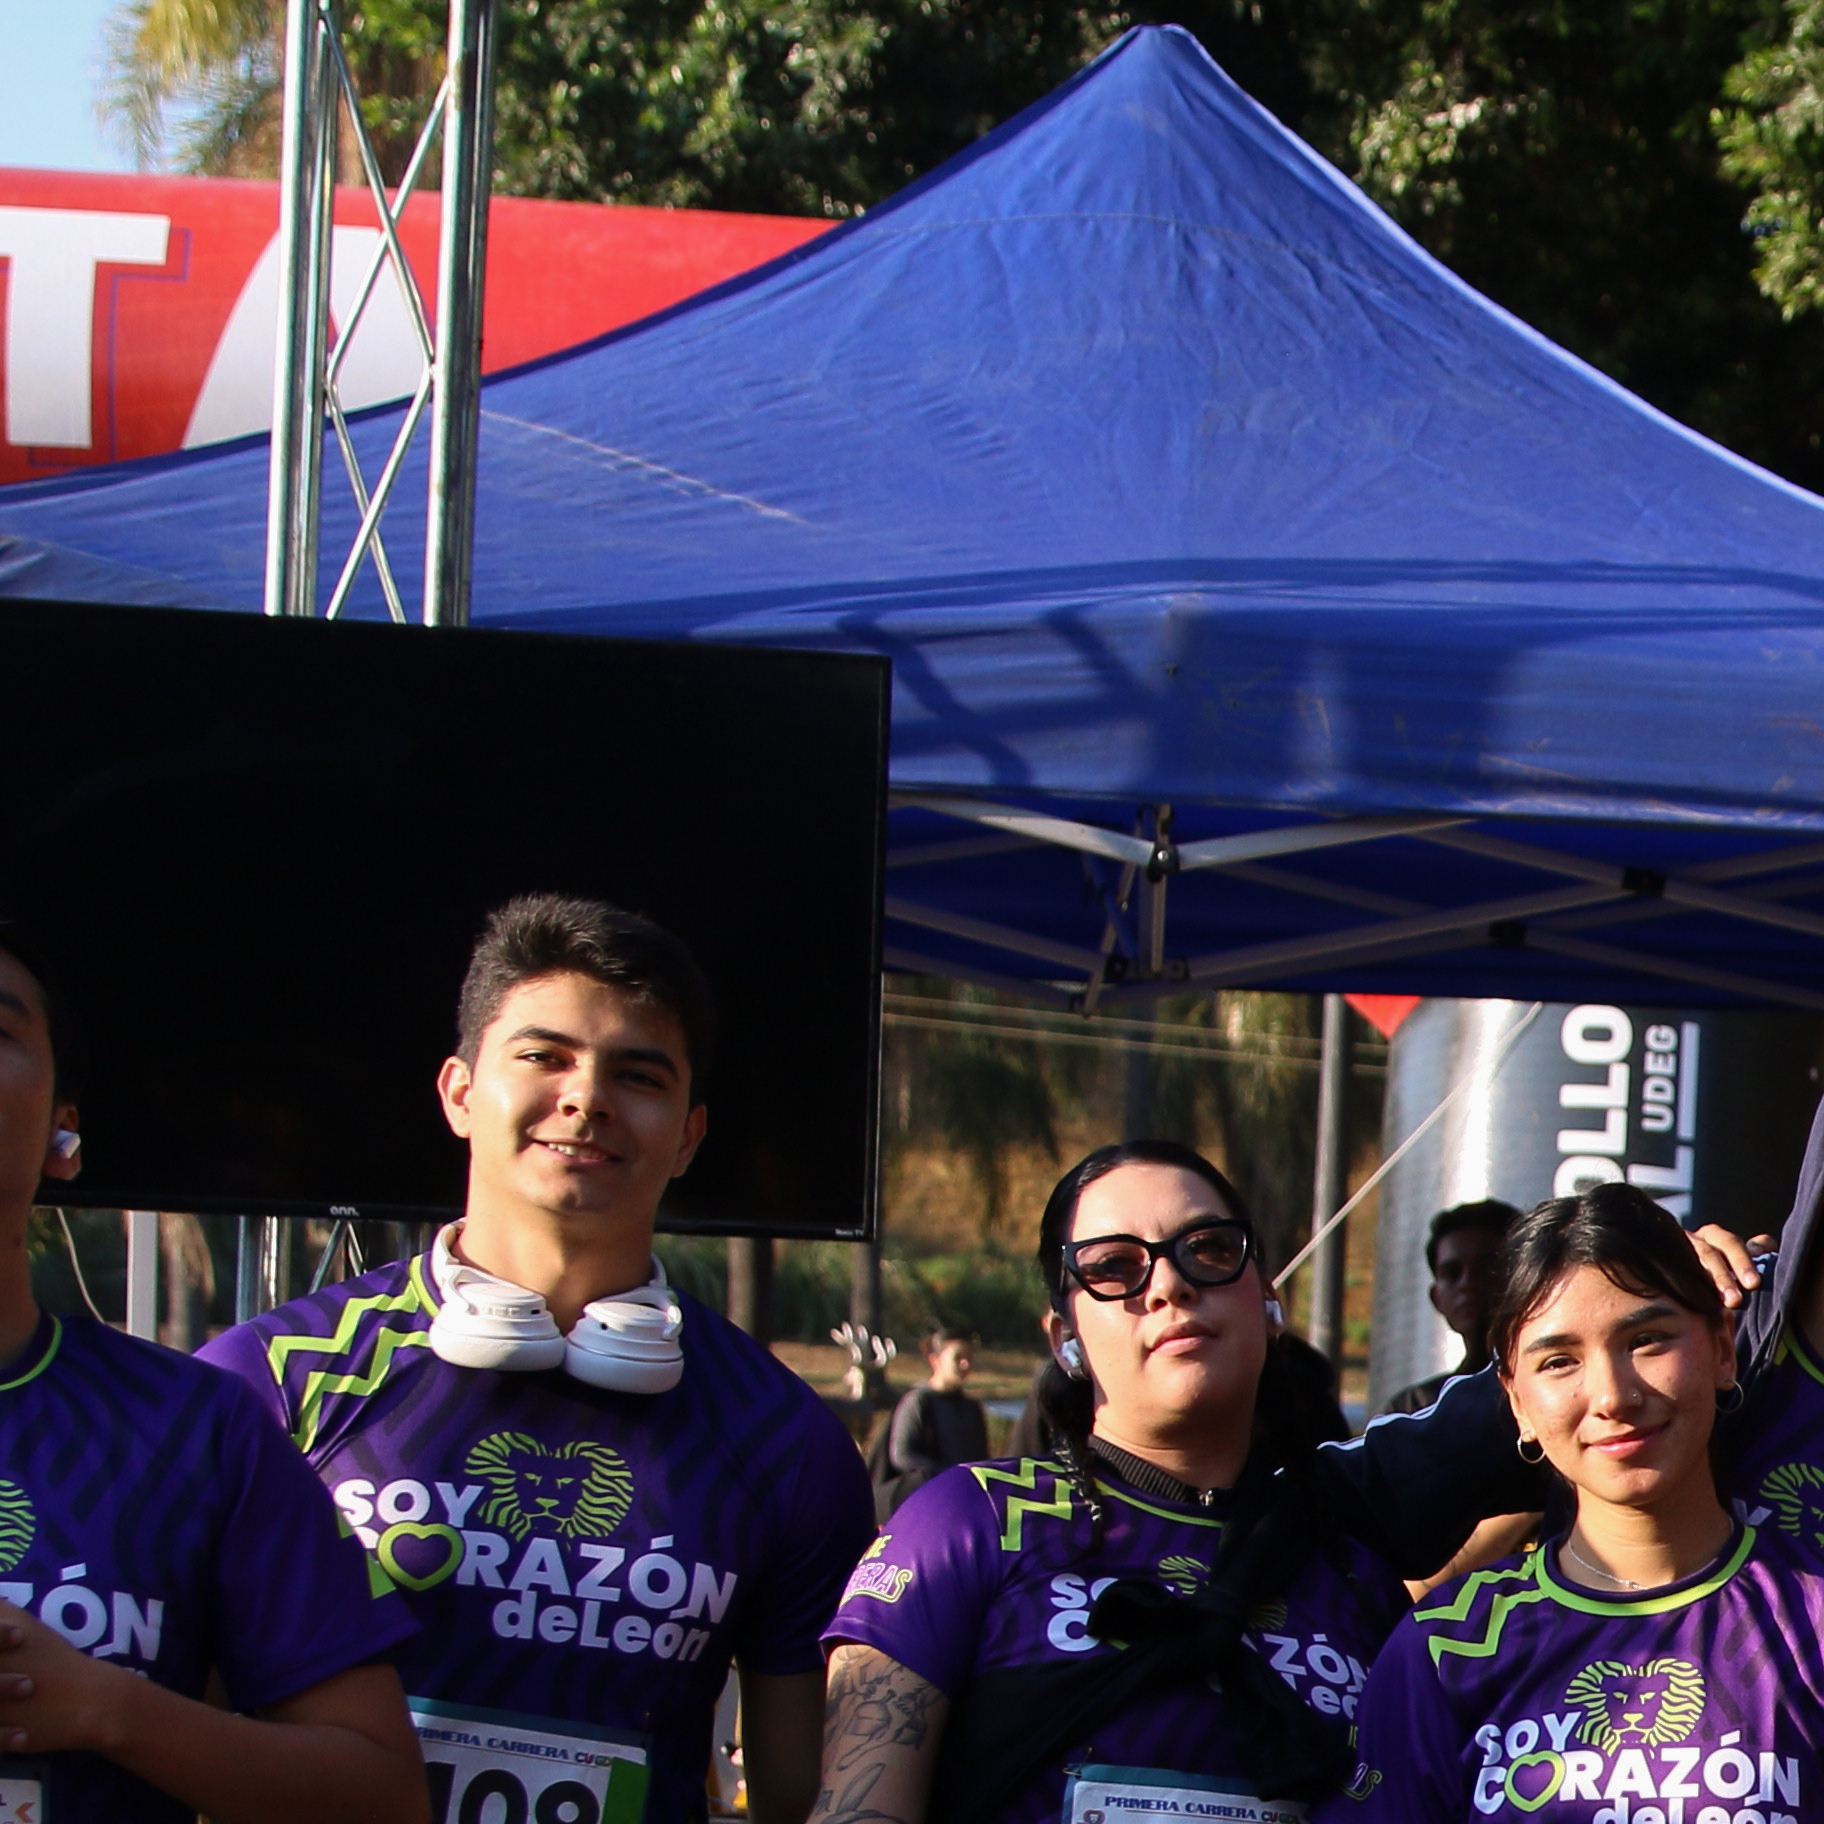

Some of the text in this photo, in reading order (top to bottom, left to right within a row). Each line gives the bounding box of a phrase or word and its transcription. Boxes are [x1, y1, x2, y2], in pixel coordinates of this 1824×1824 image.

[1641, 1024, 1679, 1132] UDEG
[334, 1479, 484, 1527] SOY
[487, 1738, 569, 1760] CARRERA
[575, 1751, 613, 1768] CUGD
[1475, 1711, 1581, 1767] SOY
[1472, 1729, 1800, 1815] CORAZÓN
[1104, 1795, 1181, 1813] PRIMERA
[1185, 1801, 1257, 1821] CARRERA
